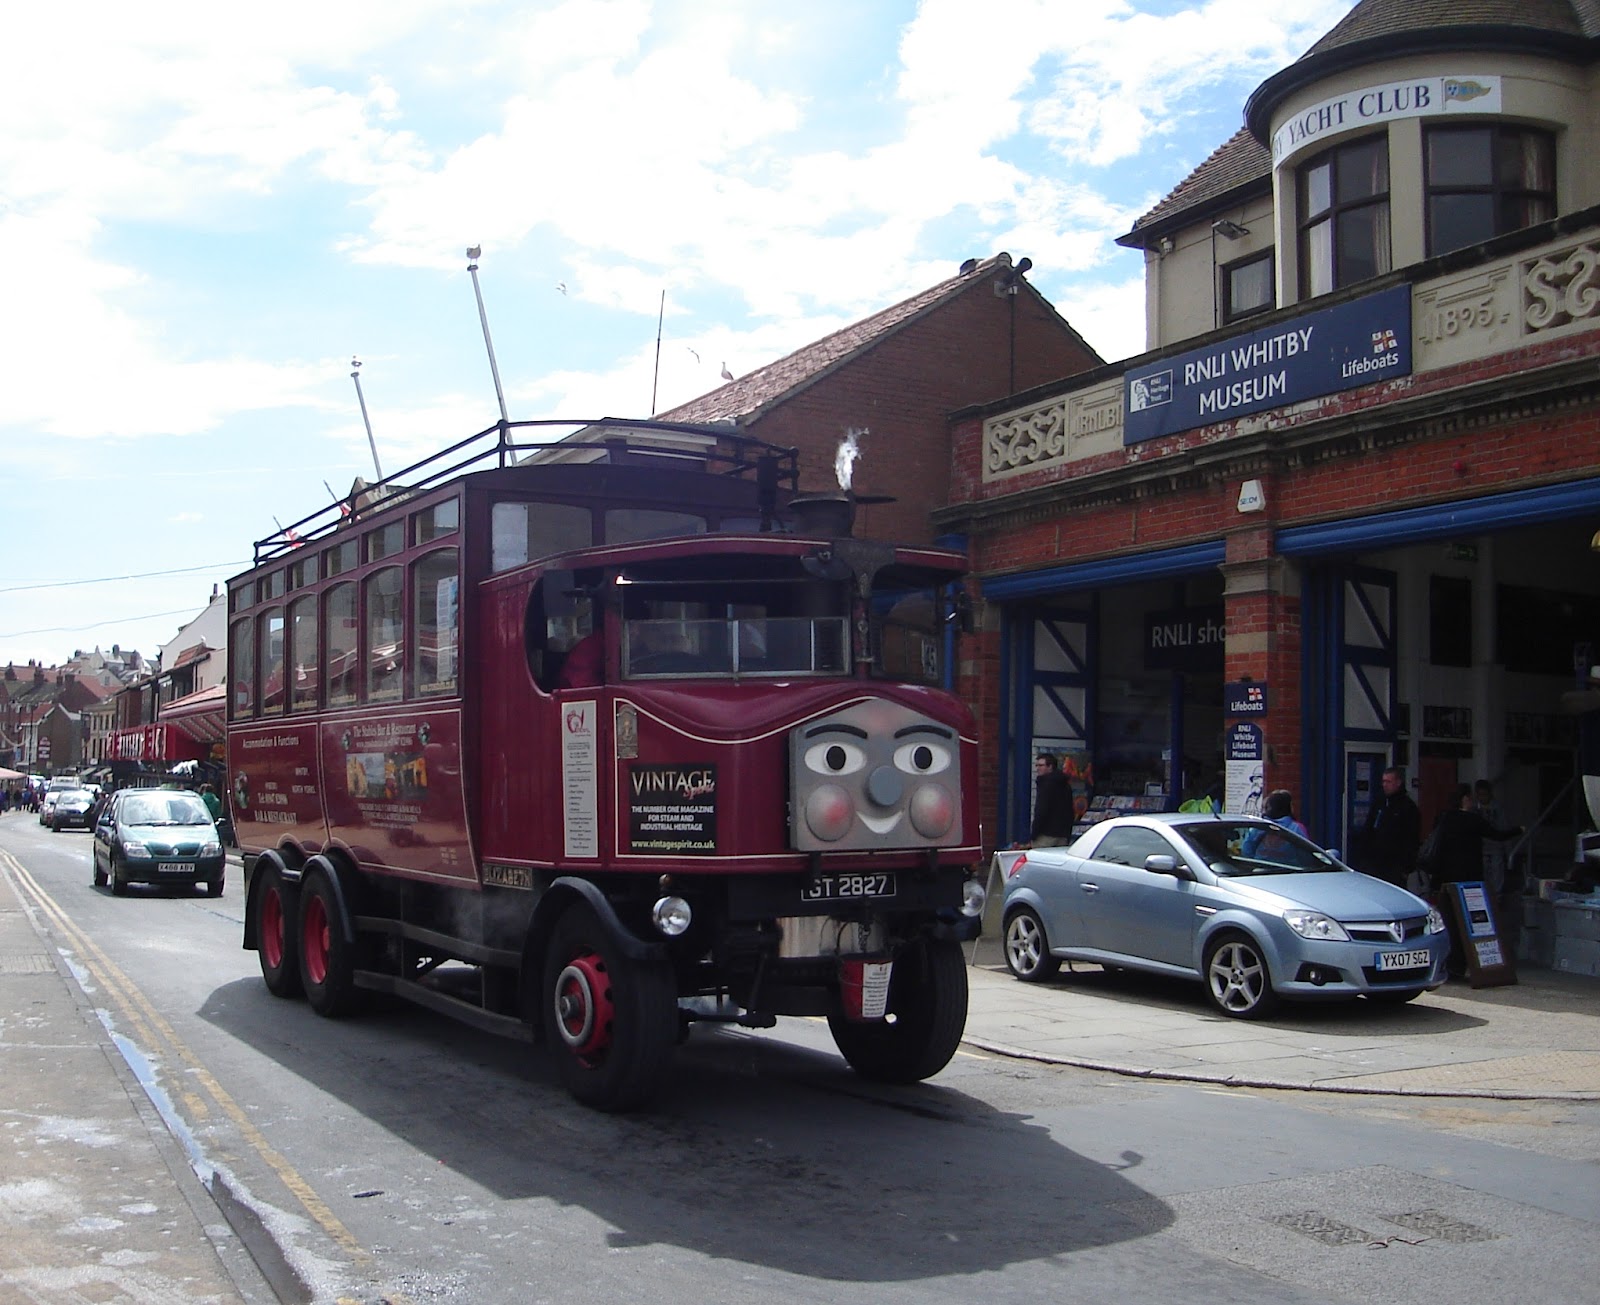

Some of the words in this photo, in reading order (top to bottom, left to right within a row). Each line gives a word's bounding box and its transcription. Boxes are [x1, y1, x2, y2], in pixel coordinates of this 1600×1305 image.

[1289, 100, 1347, 146] YACHT
[1358, 85, 1430, 117] CLUB
[1184, 352, 1226, 386] RNLI
[1231, 326, 1314, 372] WHITBY
[1342, 352, 1399, 379] Lifeboats
[1199, 370, 1286, 416] MUSEUM
[1152, 623, 1192, 648] RNLI
[1231, 701, 1264, 712] Lifeboats
[1237, 724, 1252, 733] RNLI
[1233, 733, 1256, 742] Whitby
[1232, 741, 1257, 750] Lifeboat
[1232, 750, 1257, 759] Museum
[631, 771, 713, 796] VINTAGE
[682, 780, 715, 800] Spirit
[631, 805, 643, 813] THE
[643, 805, 667, 813] NUMBER
[667, 805, 680, 813] ONE
[680, 805, 714, 813] MAGAZINE
[648, 814, 660, 822] FOR
[660, 814, 680, 822] STEAM
[680, 814, 695, 822] AND
[640, 823, 673, 831] INDUSTRIAL
[673, 823, 703, 831] HERITAGE
[631, 840, 715, 850] www.vintagespirit.co.uk
[838, 875, 887, 896] 2827
[1383, 953, 1411, 967] YX07
[1412, 951, 1429, 965] SGZ
